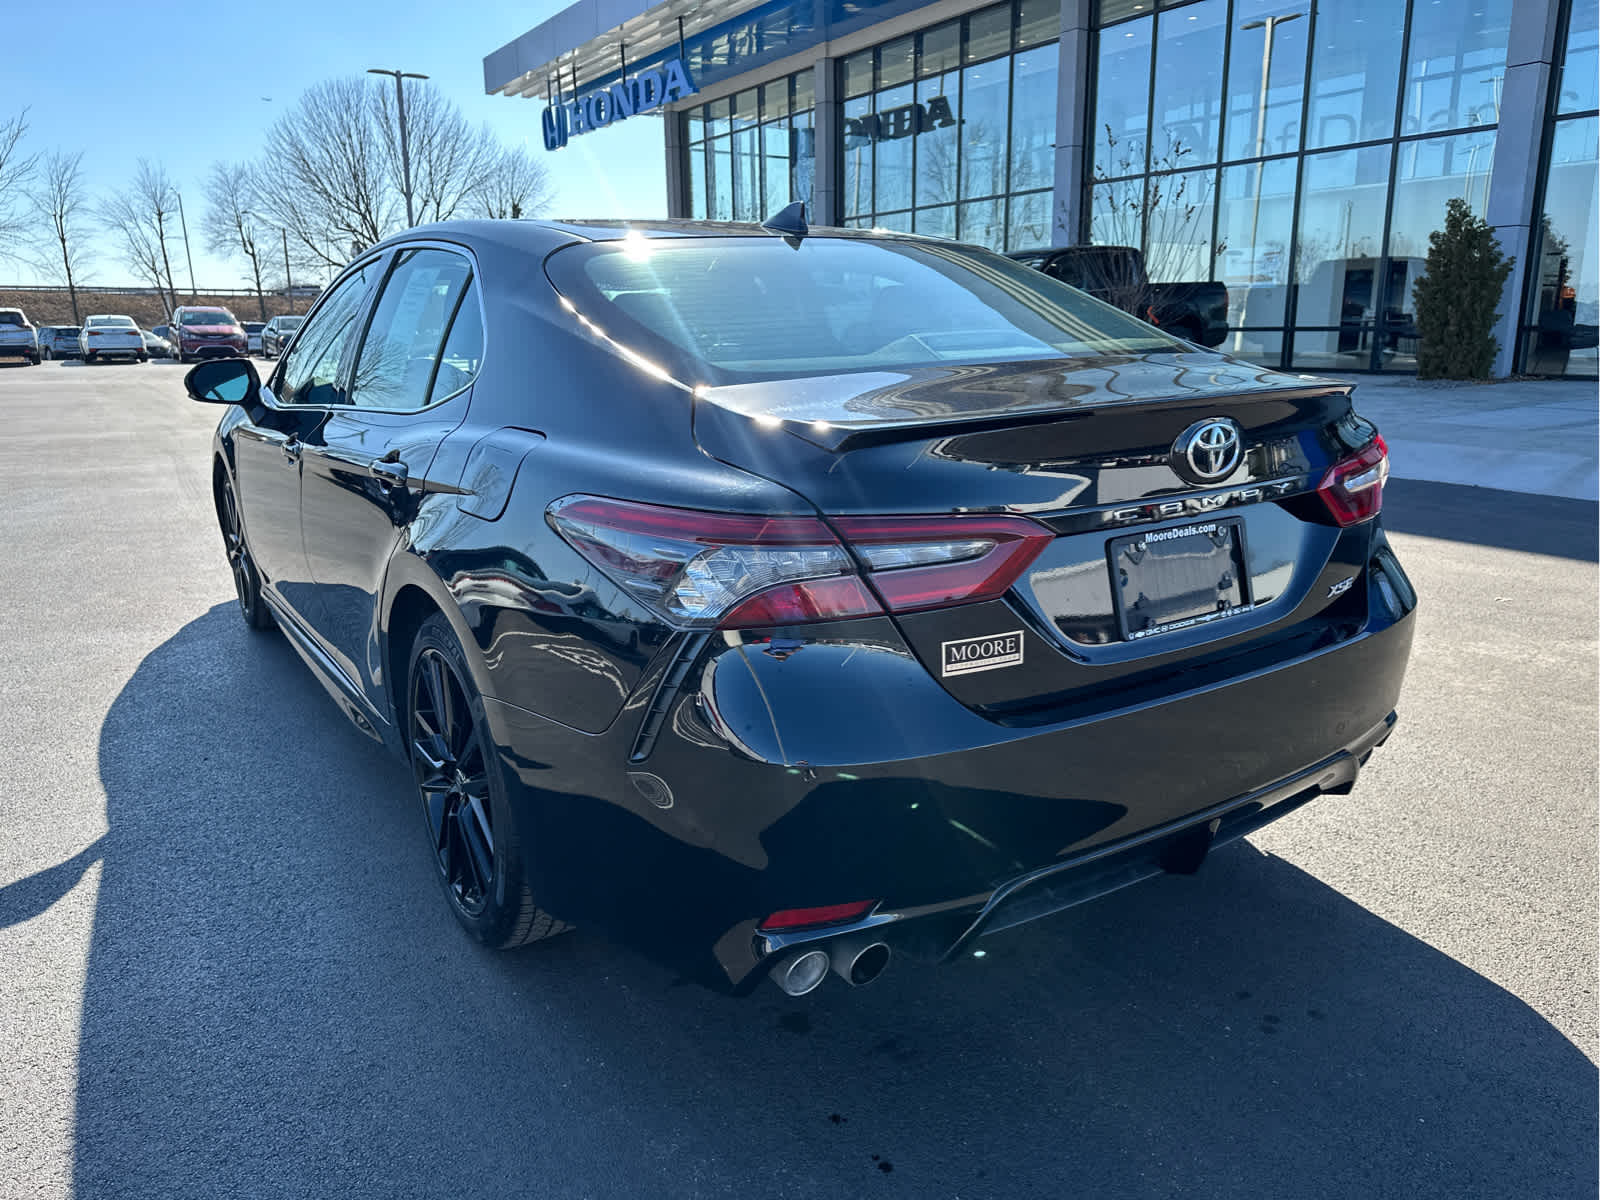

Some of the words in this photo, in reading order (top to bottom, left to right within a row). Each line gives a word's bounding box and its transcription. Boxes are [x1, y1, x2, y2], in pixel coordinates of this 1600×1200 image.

[566, 58, 696, 137] HONDA
[1114, 482, 1291, 521] CAMRY
[1145, 523, 1216, 543] MooreDeals.com
[1327, 576, 1355, 598] XSE
[950, 637, 1017, 662] MOORE
